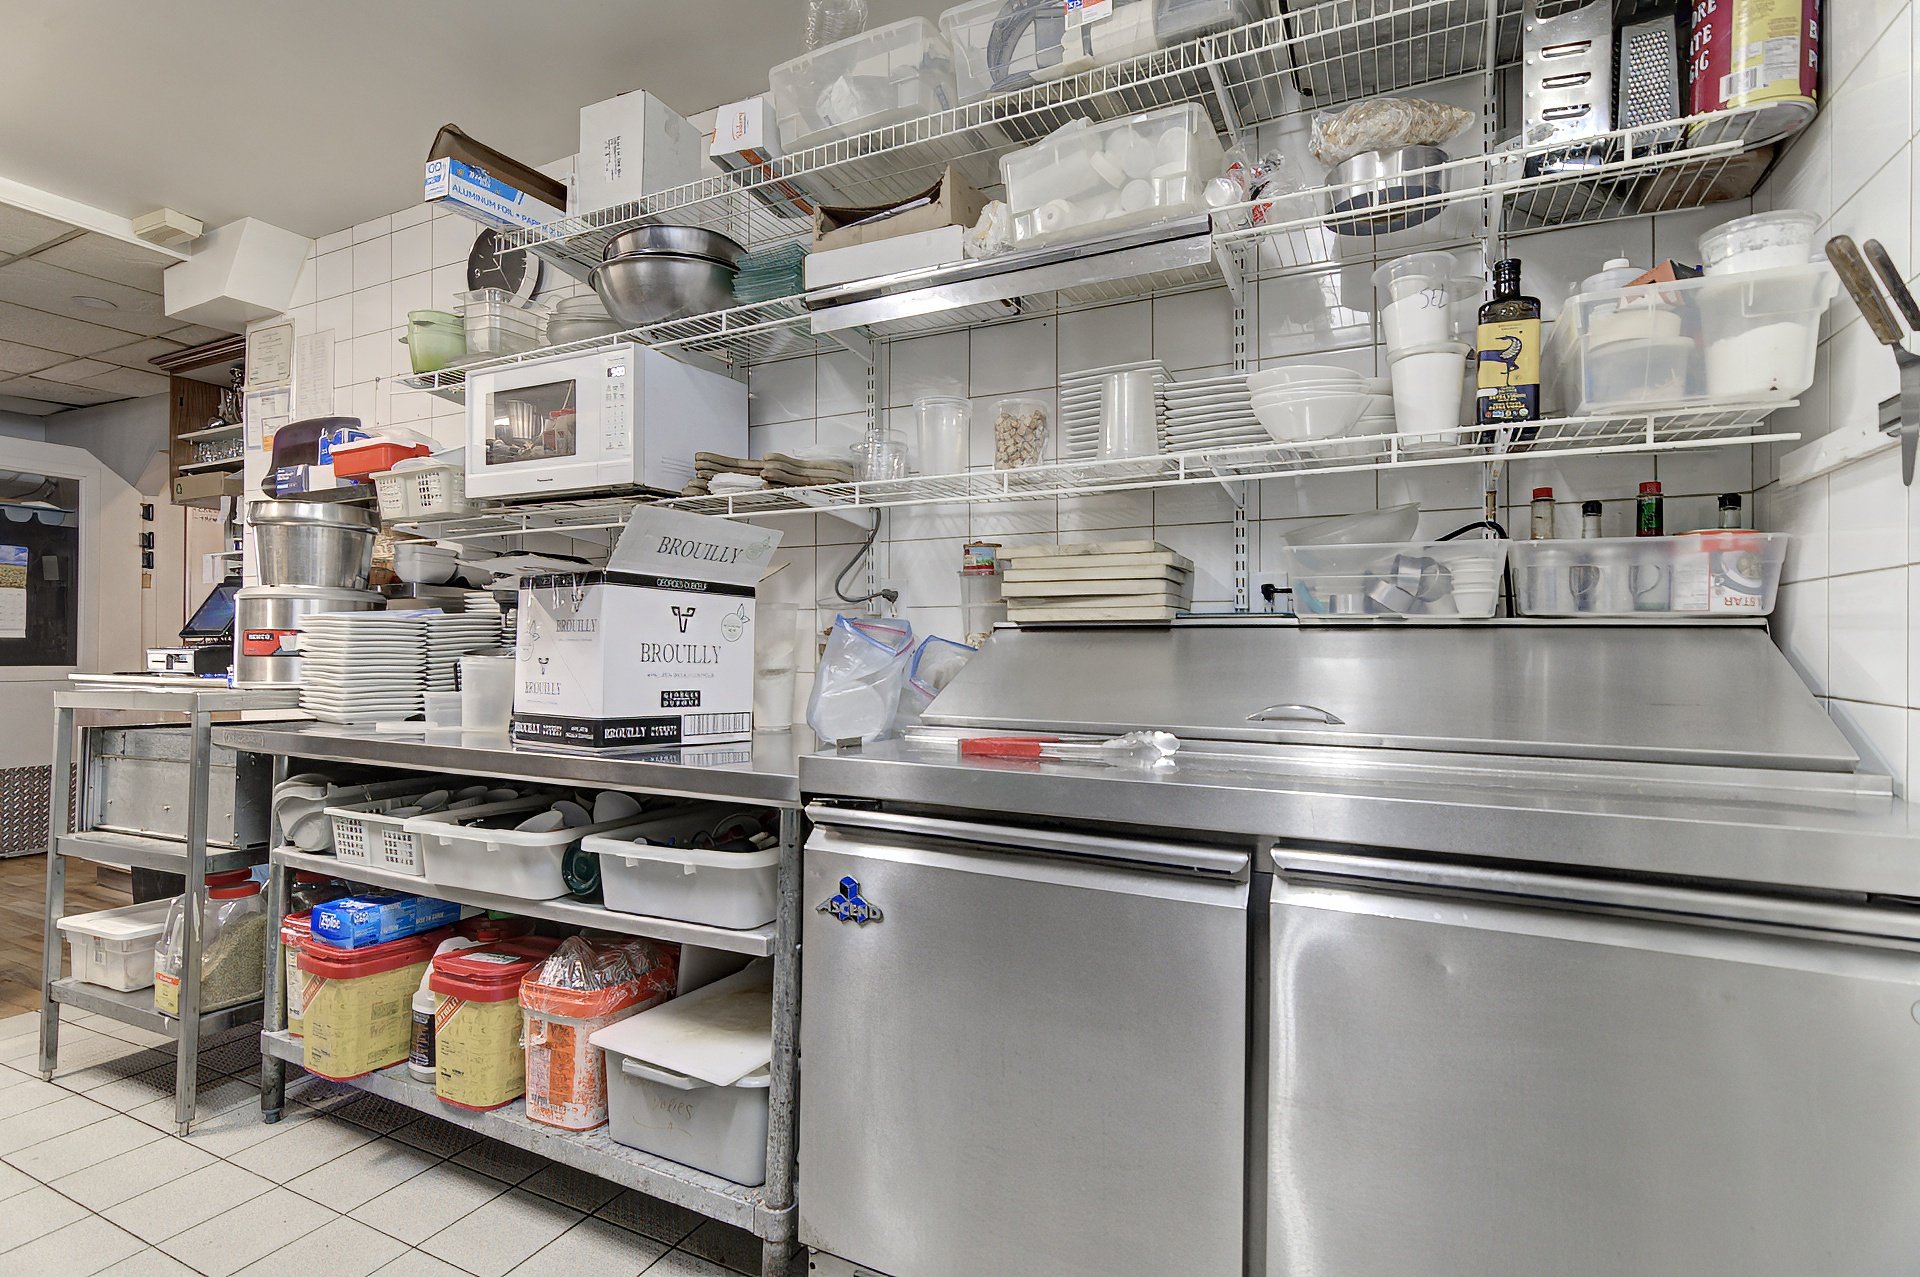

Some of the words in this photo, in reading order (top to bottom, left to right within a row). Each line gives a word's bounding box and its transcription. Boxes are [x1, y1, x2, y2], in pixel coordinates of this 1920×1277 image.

[452, 185, 496, 211] ALUMINUM
[496, 202, 514, 217] FOIL
[656, 536, 743, 564] BROUILLY
[556, 618, 598, 633] BROUILLY
[641, 643, 721, 664] BROUILLY
[525, 681, 561, 695] BROUILLY
[604, 727, 647, 740] BROUILLY
[320, 911, 341, 930] Ziploc
